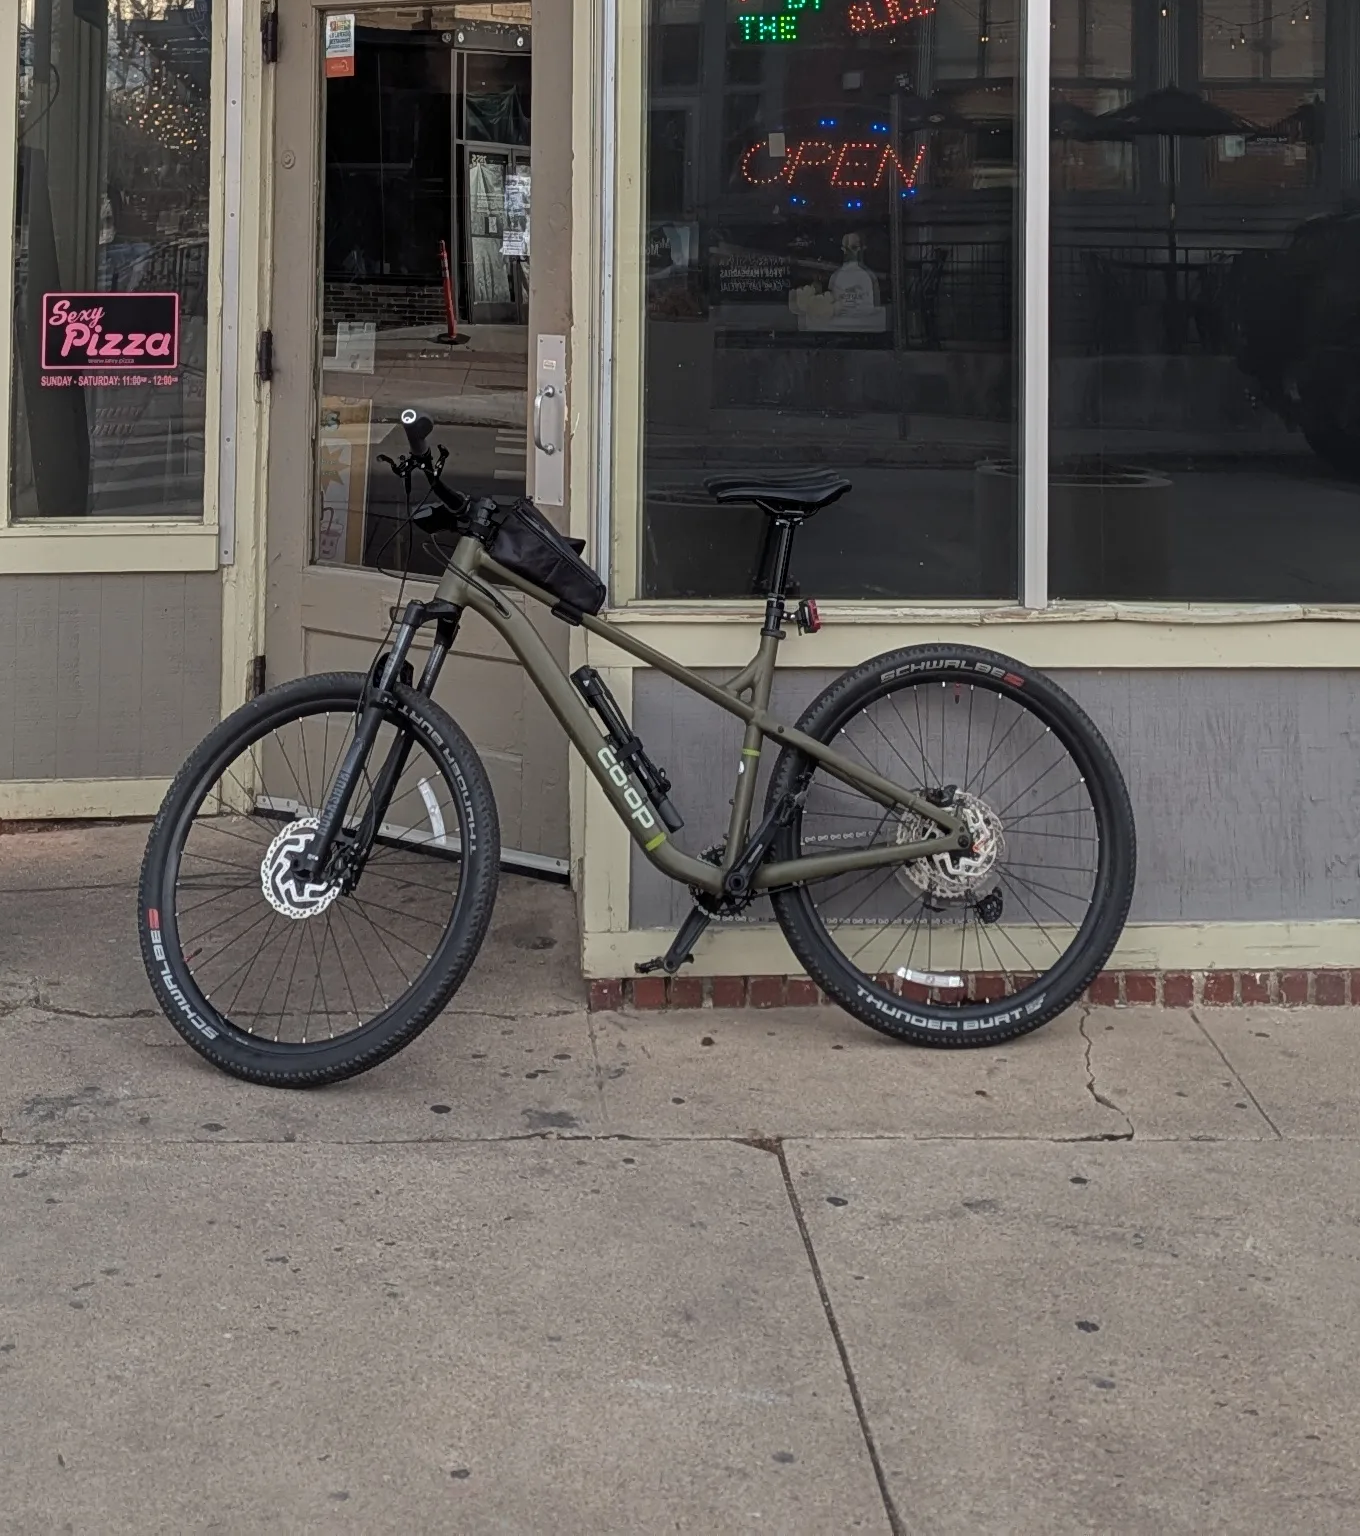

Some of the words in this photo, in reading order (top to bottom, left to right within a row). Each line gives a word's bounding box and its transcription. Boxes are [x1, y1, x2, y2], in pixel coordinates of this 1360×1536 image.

[739, 16, 797, 40] THE
[741, 141, 926, 188] OPEN
[49, 300, 105, 328] Sexy
[60, 322, 172, 357] Pizza
[40, 375, 72, 386] SUNDAY
[78, 375, 121, 386] SATURDAY:
[880, 659, 1006, 684] SCHWALBE
[442, 747, 477, 856] THUNDER
[150, 929, 219, 1040] SCHWALBE
[856, 984, 958, 1031] THUNDER
[962, 1007, 1025, 1031] BURT
